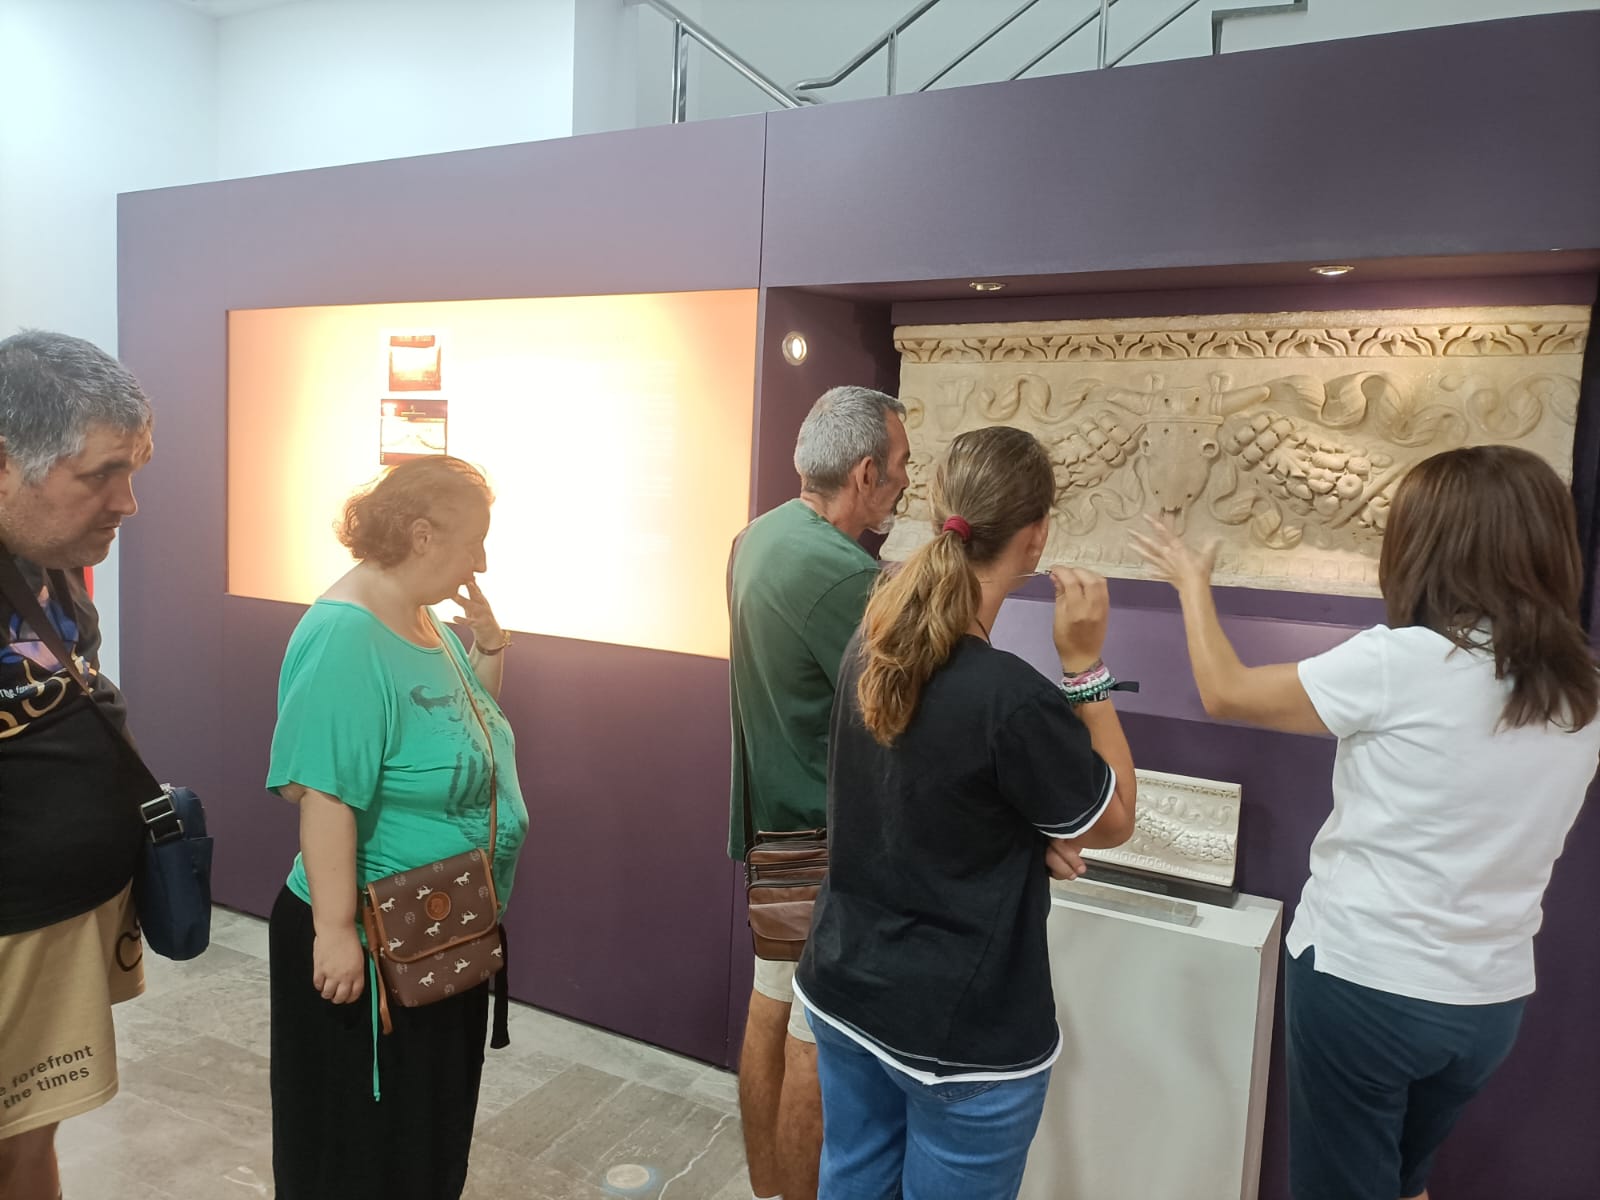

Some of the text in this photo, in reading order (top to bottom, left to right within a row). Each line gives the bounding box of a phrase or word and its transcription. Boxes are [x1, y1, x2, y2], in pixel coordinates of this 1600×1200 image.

[12, 1045, 93, 1087] forefront
[3, 1067, 90, 1109] the times
